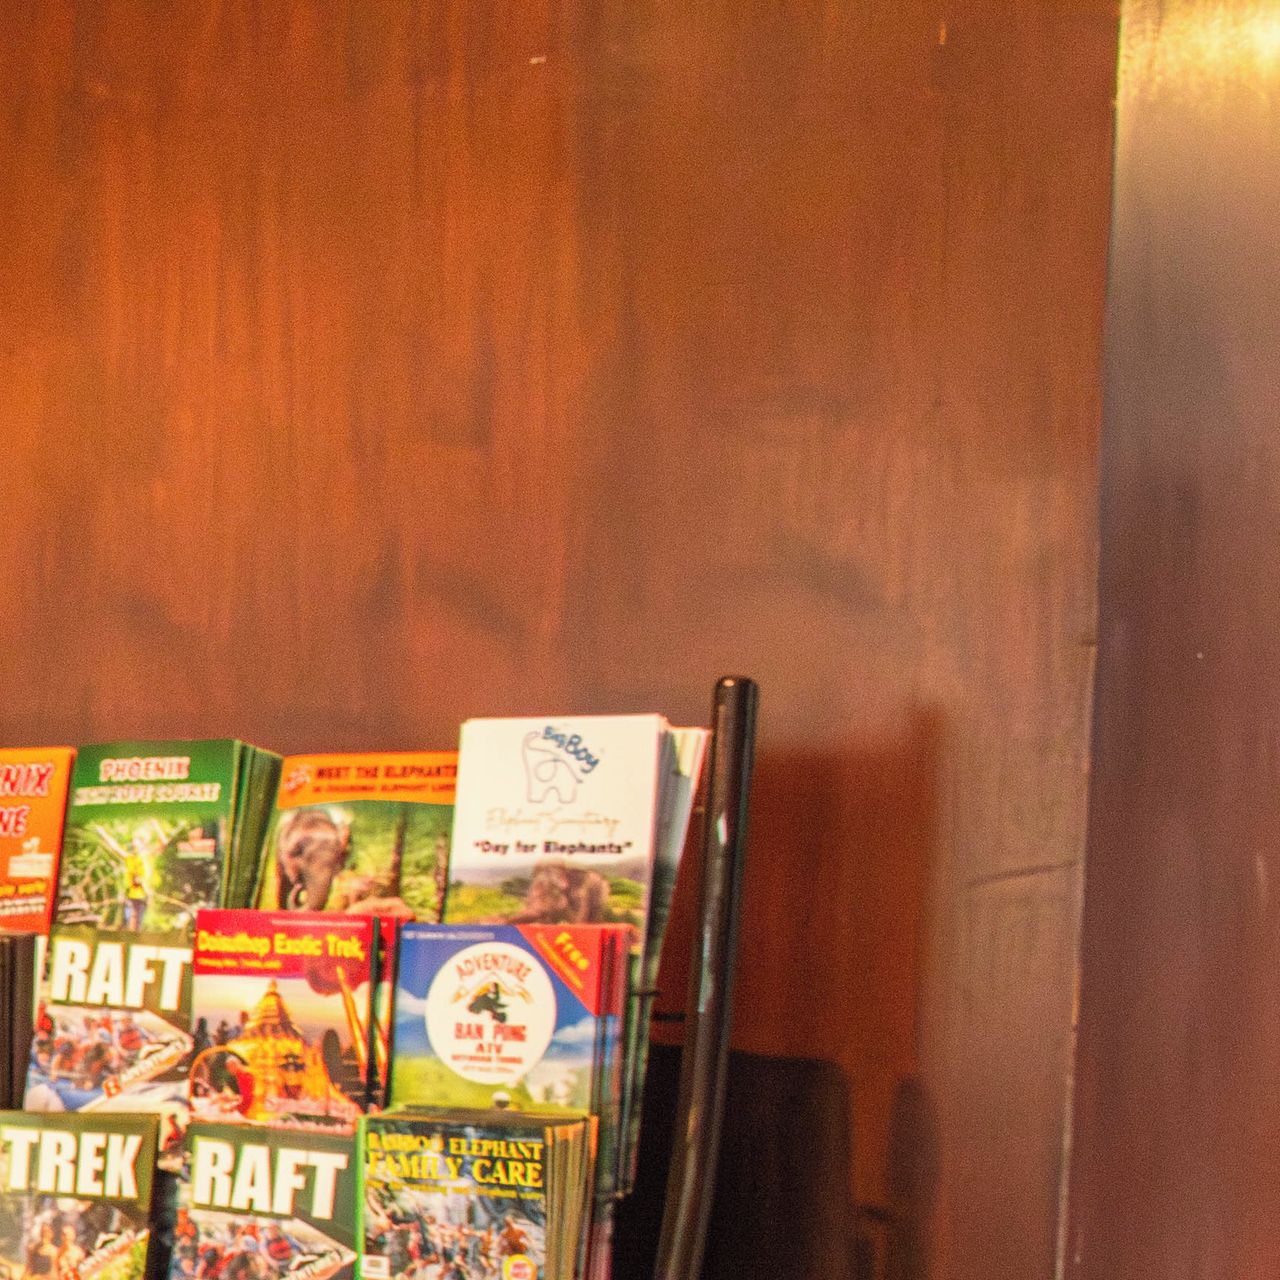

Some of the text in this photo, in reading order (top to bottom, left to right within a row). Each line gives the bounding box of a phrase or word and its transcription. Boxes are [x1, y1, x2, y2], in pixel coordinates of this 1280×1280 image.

[356, 765, 378, 779] THE
[515, 839, 537, 852] for
[50, 938, 195, 1011] RAFT
[455, 952, 533, 983] ADVENTURE
[448, 1137, 544, 1161] ELEPHANT
[191, 1135, 349, 1220] RAFT
[368, 1152, 544, 1188] FAMILY CARE
